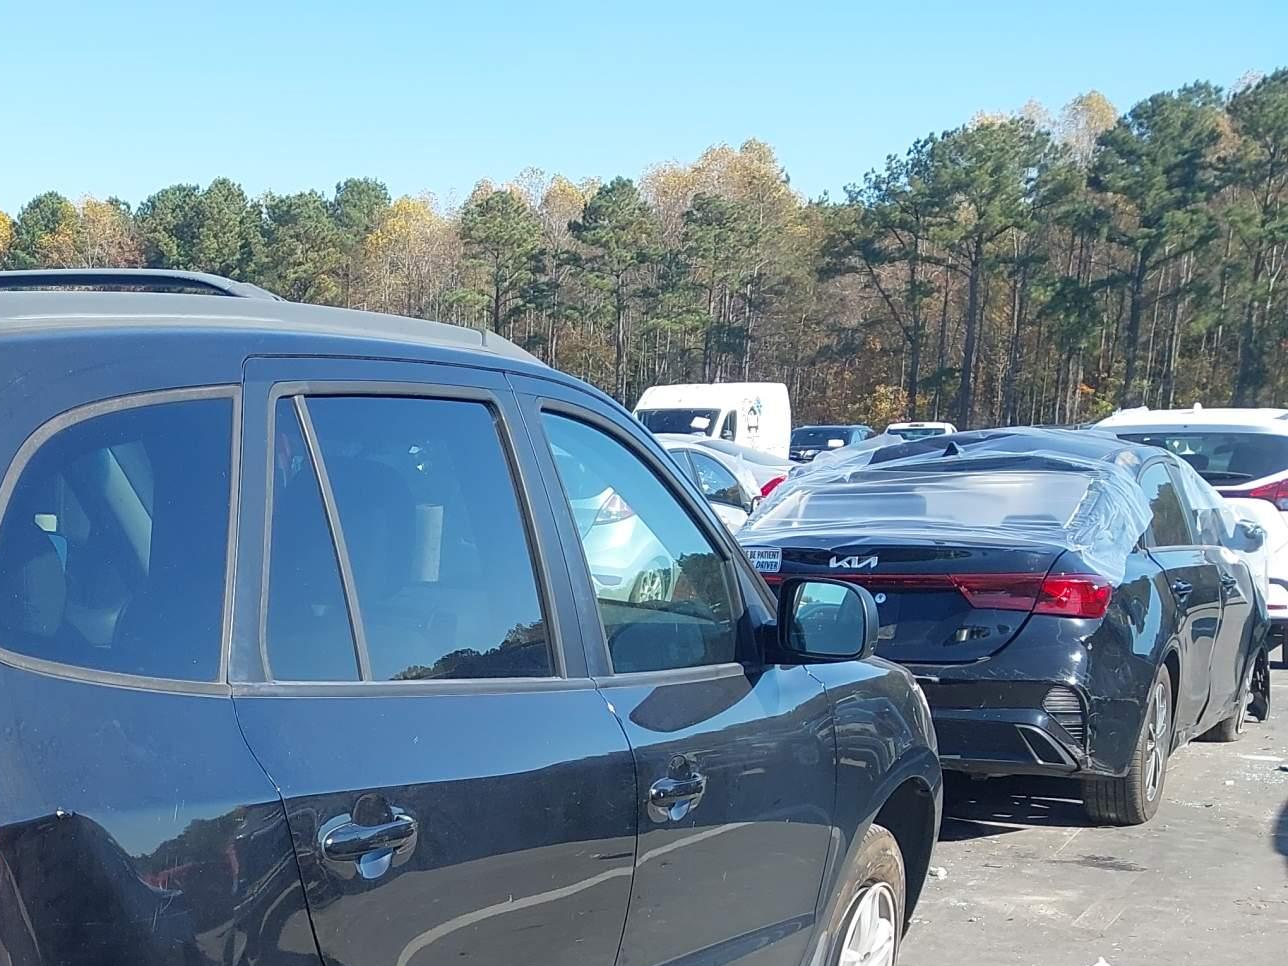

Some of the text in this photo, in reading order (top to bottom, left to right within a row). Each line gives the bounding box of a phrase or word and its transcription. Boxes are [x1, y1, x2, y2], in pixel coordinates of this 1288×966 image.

[749, 551, 757, 559] BE
[757, 551, 779, 560] PATIENT
[755, 560, 778, 570] DRIVER
[829, 556, 878, 568] KIA
